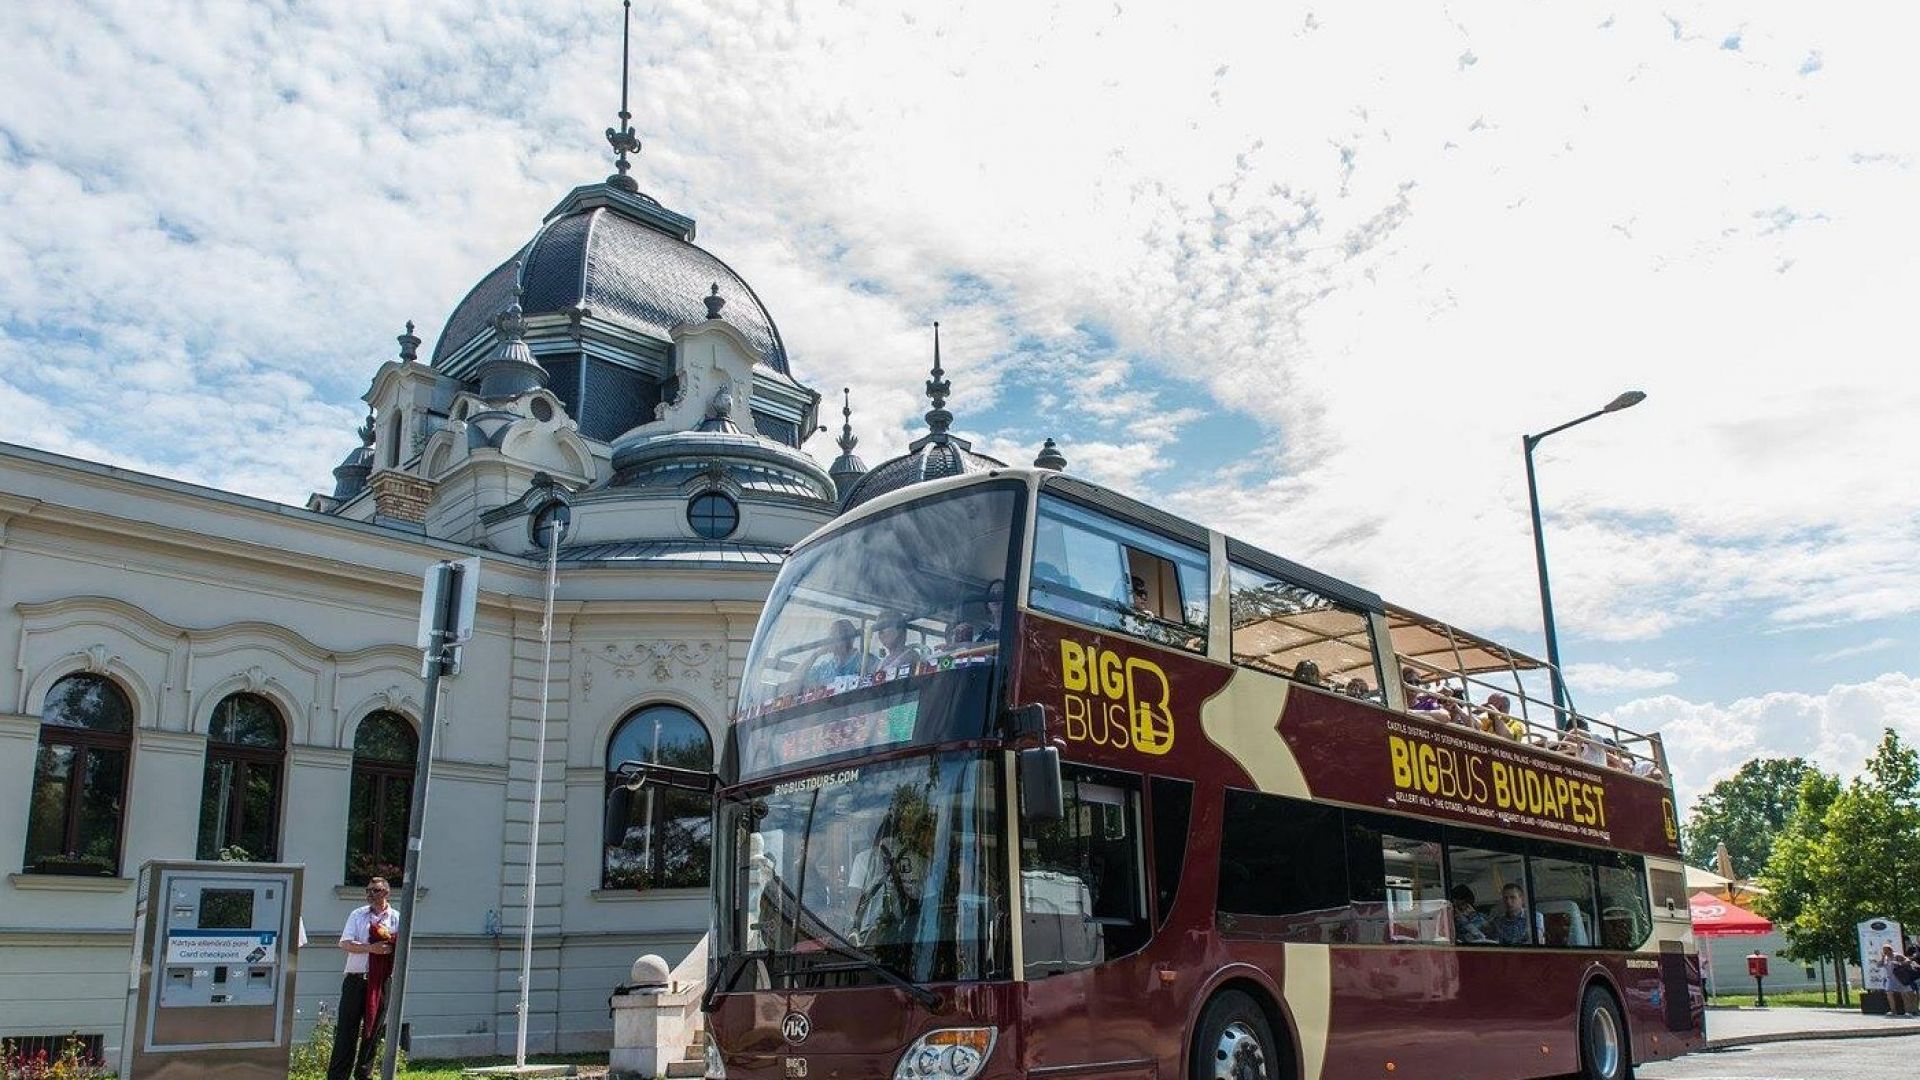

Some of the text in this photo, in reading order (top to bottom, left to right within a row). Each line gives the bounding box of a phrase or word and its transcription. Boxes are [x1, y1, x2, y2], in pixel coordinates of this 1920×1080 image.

[1060, 639, 1124, 699] BIG
[1065, 694, 1129, 749] BUS
[774, 768, 860, 796] BIGBUSTOURS.COM
[1492, 761, 1605, 827] BUDAPEST
[180, 950, 240, 959] Card checkpoint
